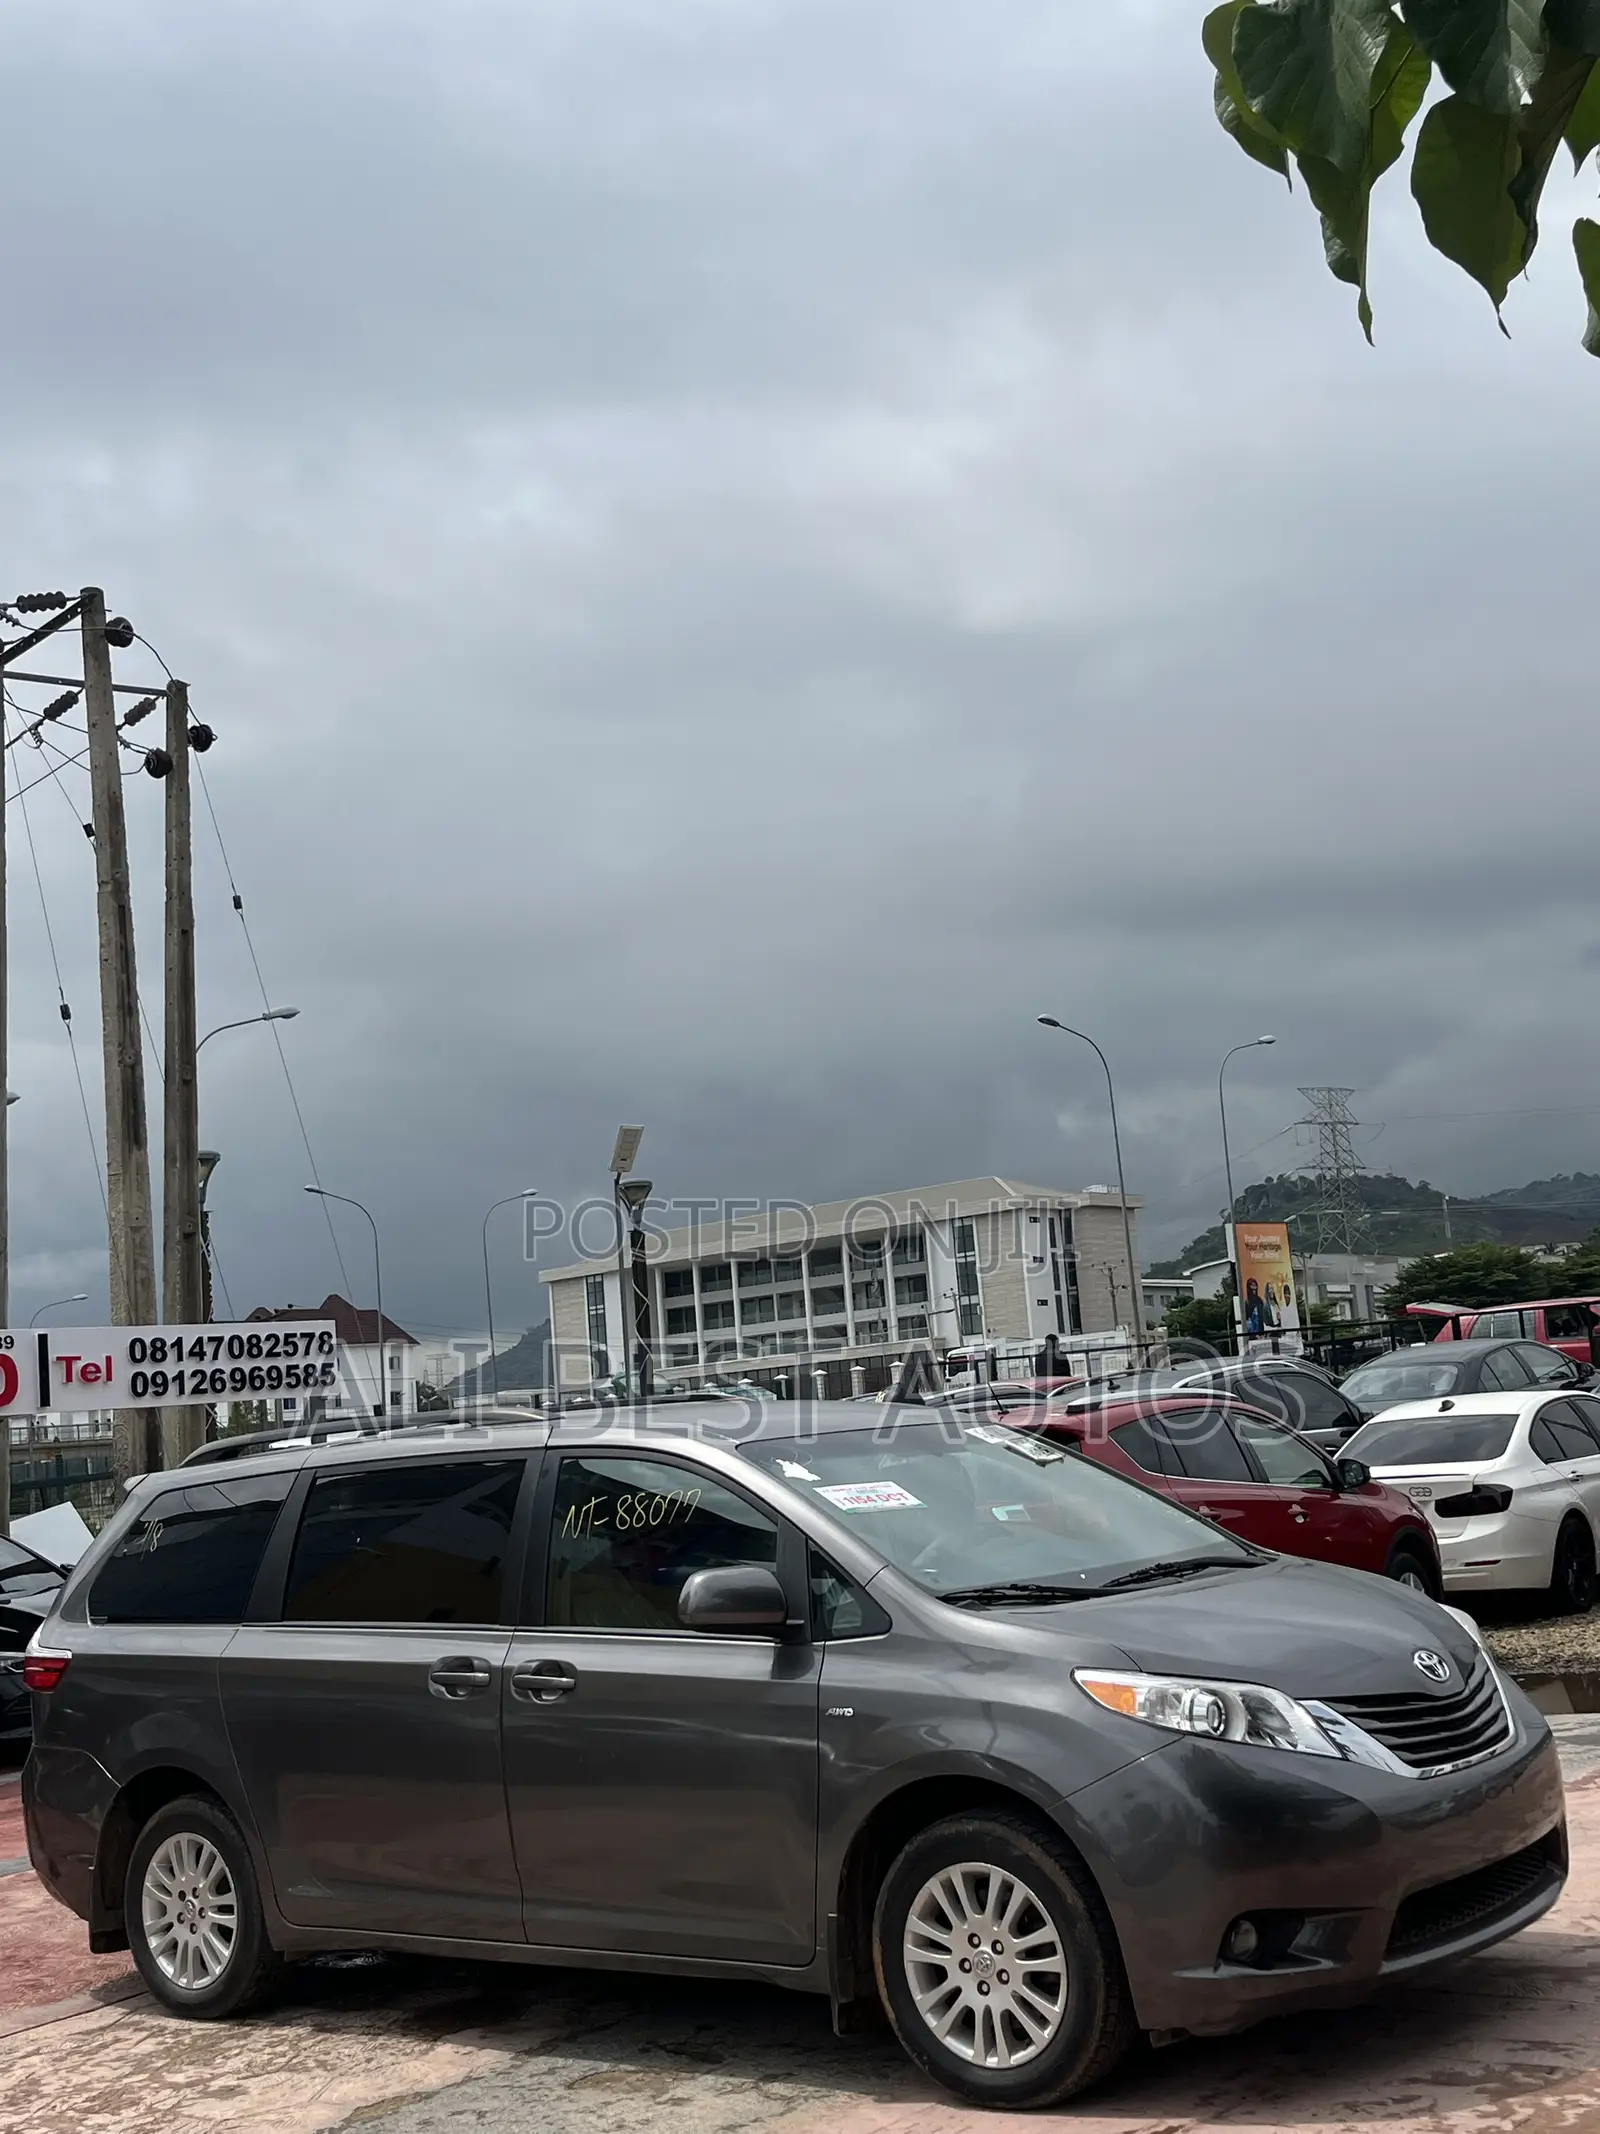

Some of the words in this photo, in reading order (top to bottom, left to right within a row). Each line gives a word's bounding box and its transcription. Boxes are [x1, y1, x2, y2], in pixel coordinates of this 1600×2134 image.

[128, 1331, 334, 1364] 08147082578
[56, 1355, 112, 1383] Tel
[130, 1363, 336, 1398] 09126969585
